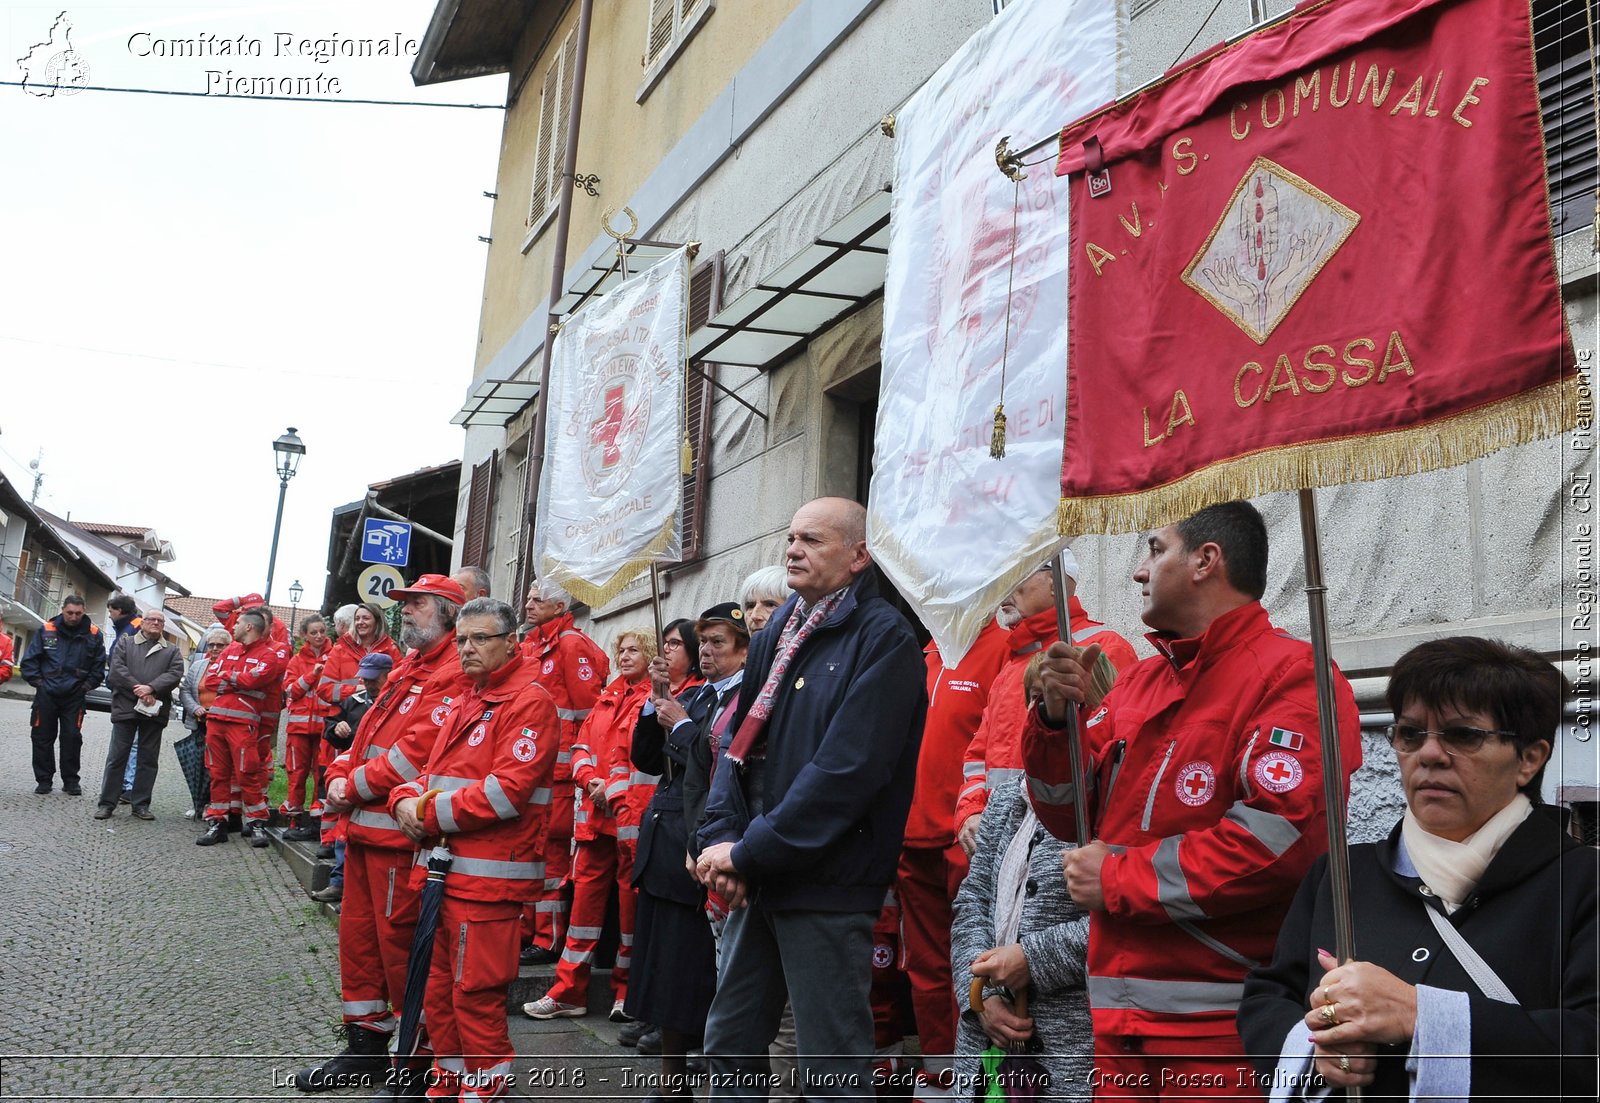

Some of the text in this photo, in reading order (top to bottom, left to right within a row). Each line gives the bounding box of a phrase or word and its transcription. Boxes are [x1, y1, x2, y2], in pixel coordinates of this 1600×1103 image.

[1230, 61, 1489, 140] COMUNALE
[1141, 330, 1415, 447] LA CASSA
[368, 575, 395, 598] 20
